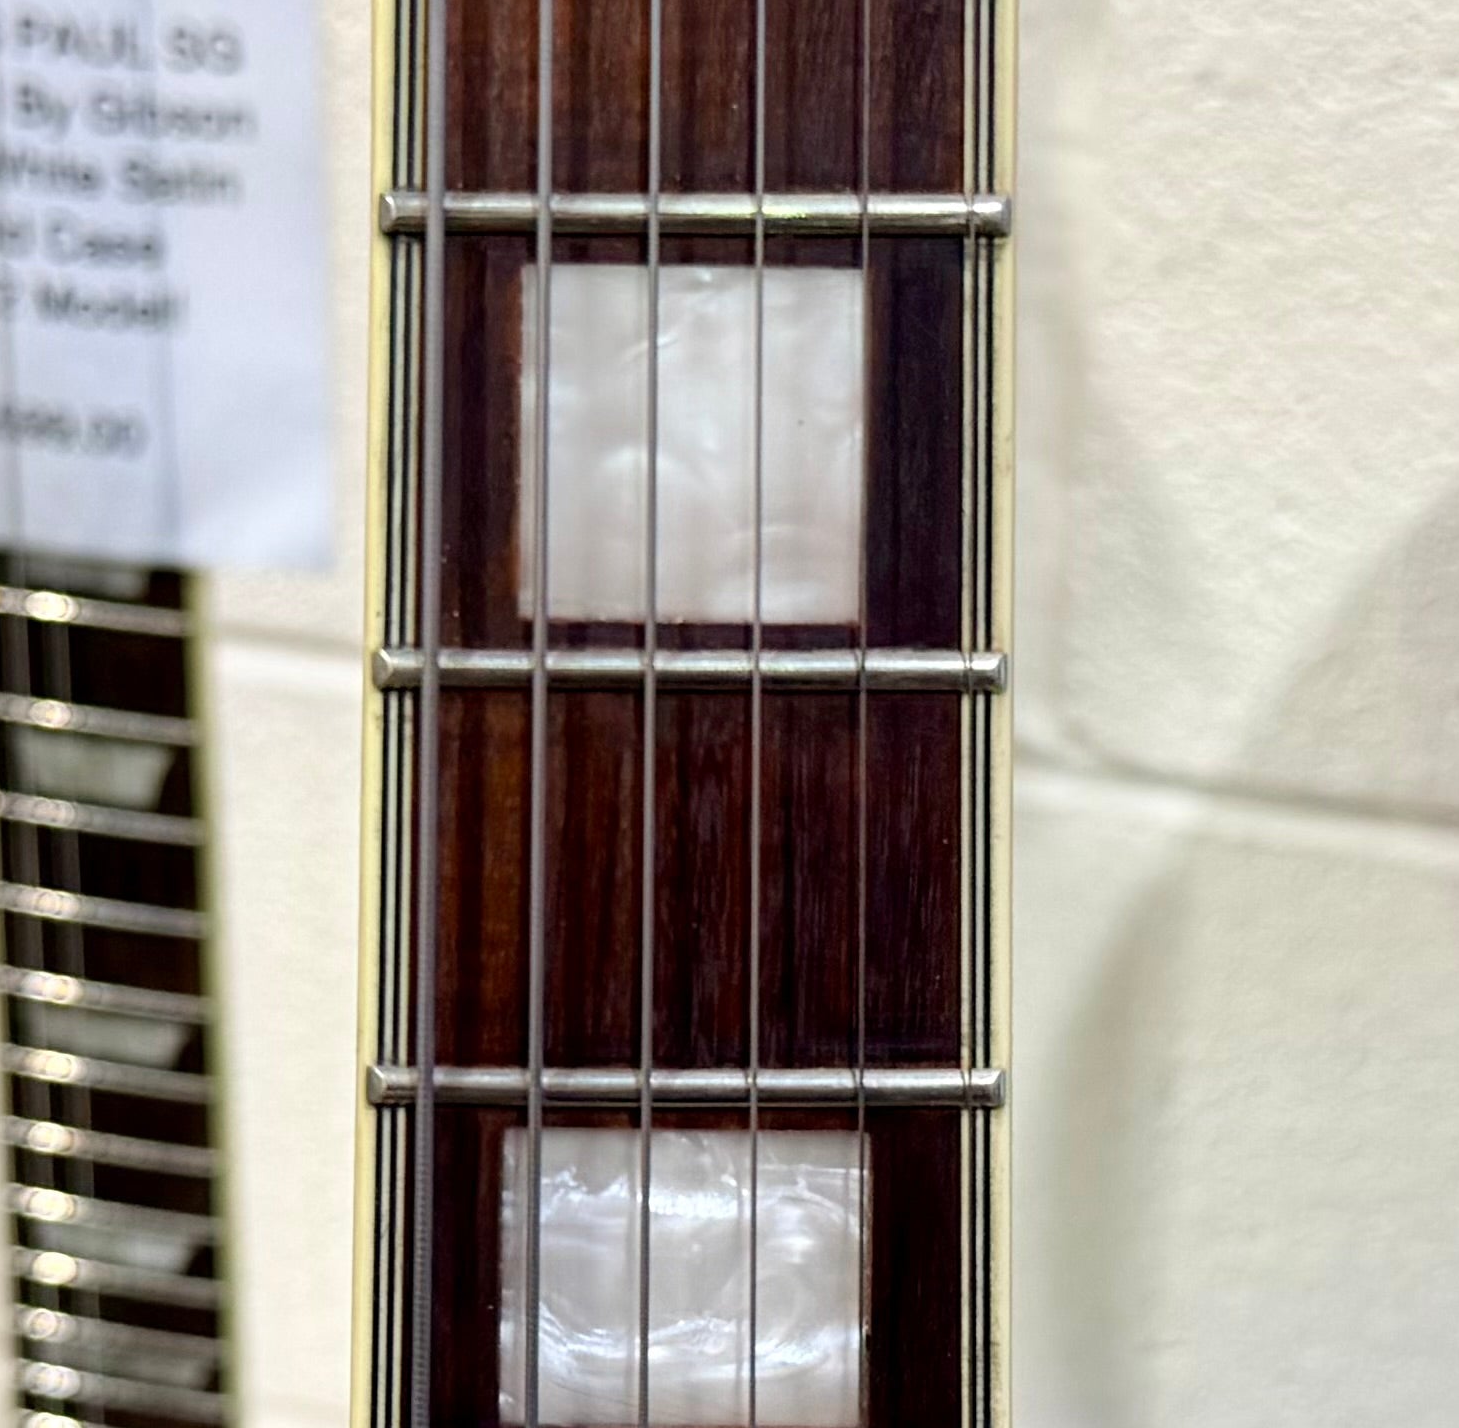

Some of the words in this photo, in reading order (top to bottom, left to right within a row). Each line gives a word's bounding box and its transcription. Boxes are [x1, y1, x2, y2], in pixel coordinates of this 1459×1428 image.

[11, 6, 153, 68] PAUL
[162, 13, 249, 74] SG
[10, 73, 77, 138] By
[82, 81, 256, 140] Gibson
